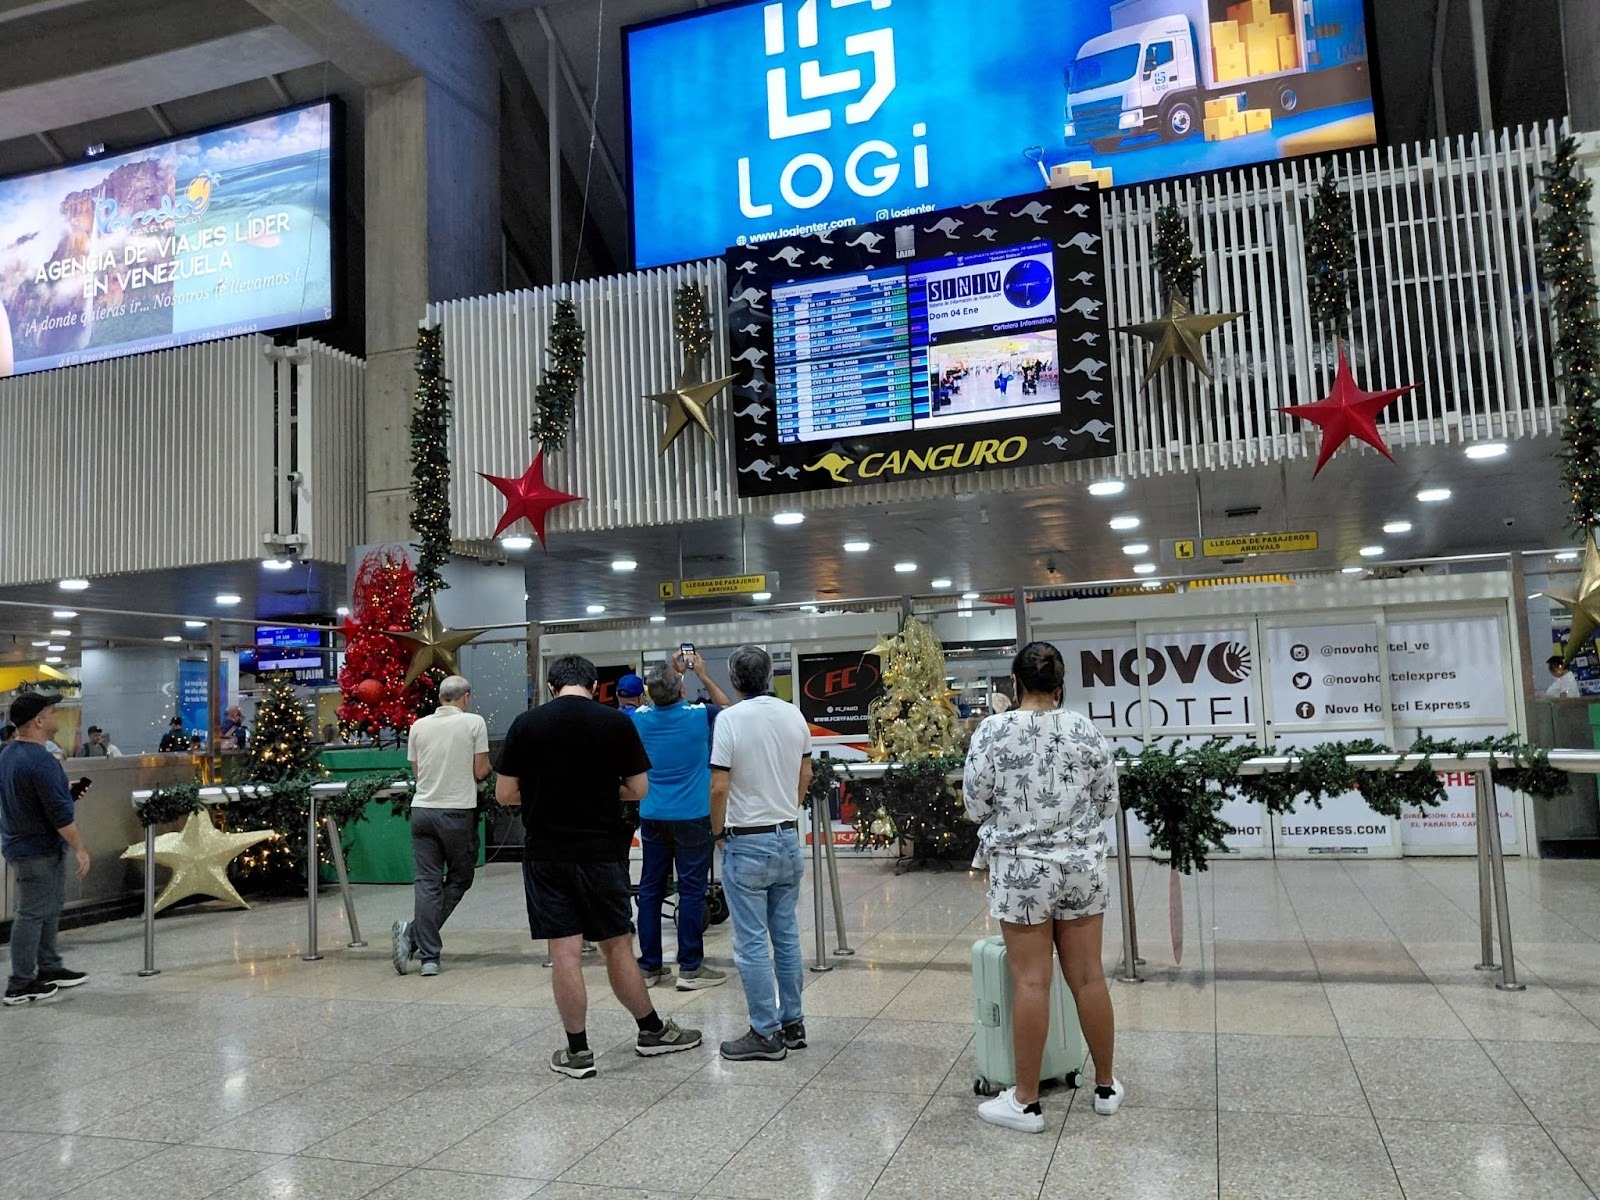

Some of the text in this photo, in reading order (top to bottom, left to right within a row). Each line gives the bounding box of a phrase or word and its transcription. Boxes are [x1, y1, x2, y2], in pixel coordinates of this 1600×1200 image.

[34, 212, 291, 285] AGENCIA DE VIAJES LÍDER
[82, 252, 233, 299] EN VENEZUELA
[929, 271, 1001, 302] SINIV
[41, 312, 77, 331] donde
[81, 302, 126, 324] quieras
[153, 287, 209, 310] Nosotros
[230, 271, 290, 293] llevamos
[929, 306, 979, 320] Dom 04 Ene
[992, 322, 1019, 332] Cartelera
[857, 436, 1028, 478] CANGURO
[1210, 538, 1247, 547] LLEGADA
[1262, 534, 1310, 543] PASAJEROS
[1240, 544, 1281, 552] ARRIVALS
[302, 669, 324, 680] IAIM
[1080, 641, 1252, 688] NOVO
[825, 666, 858, 694] FC
[1324, 703, 1359, 715] Novo
[1415, 700, 1471, 713] Express
[1281, 825, 1386, 836] ELEXPRESS.COM
